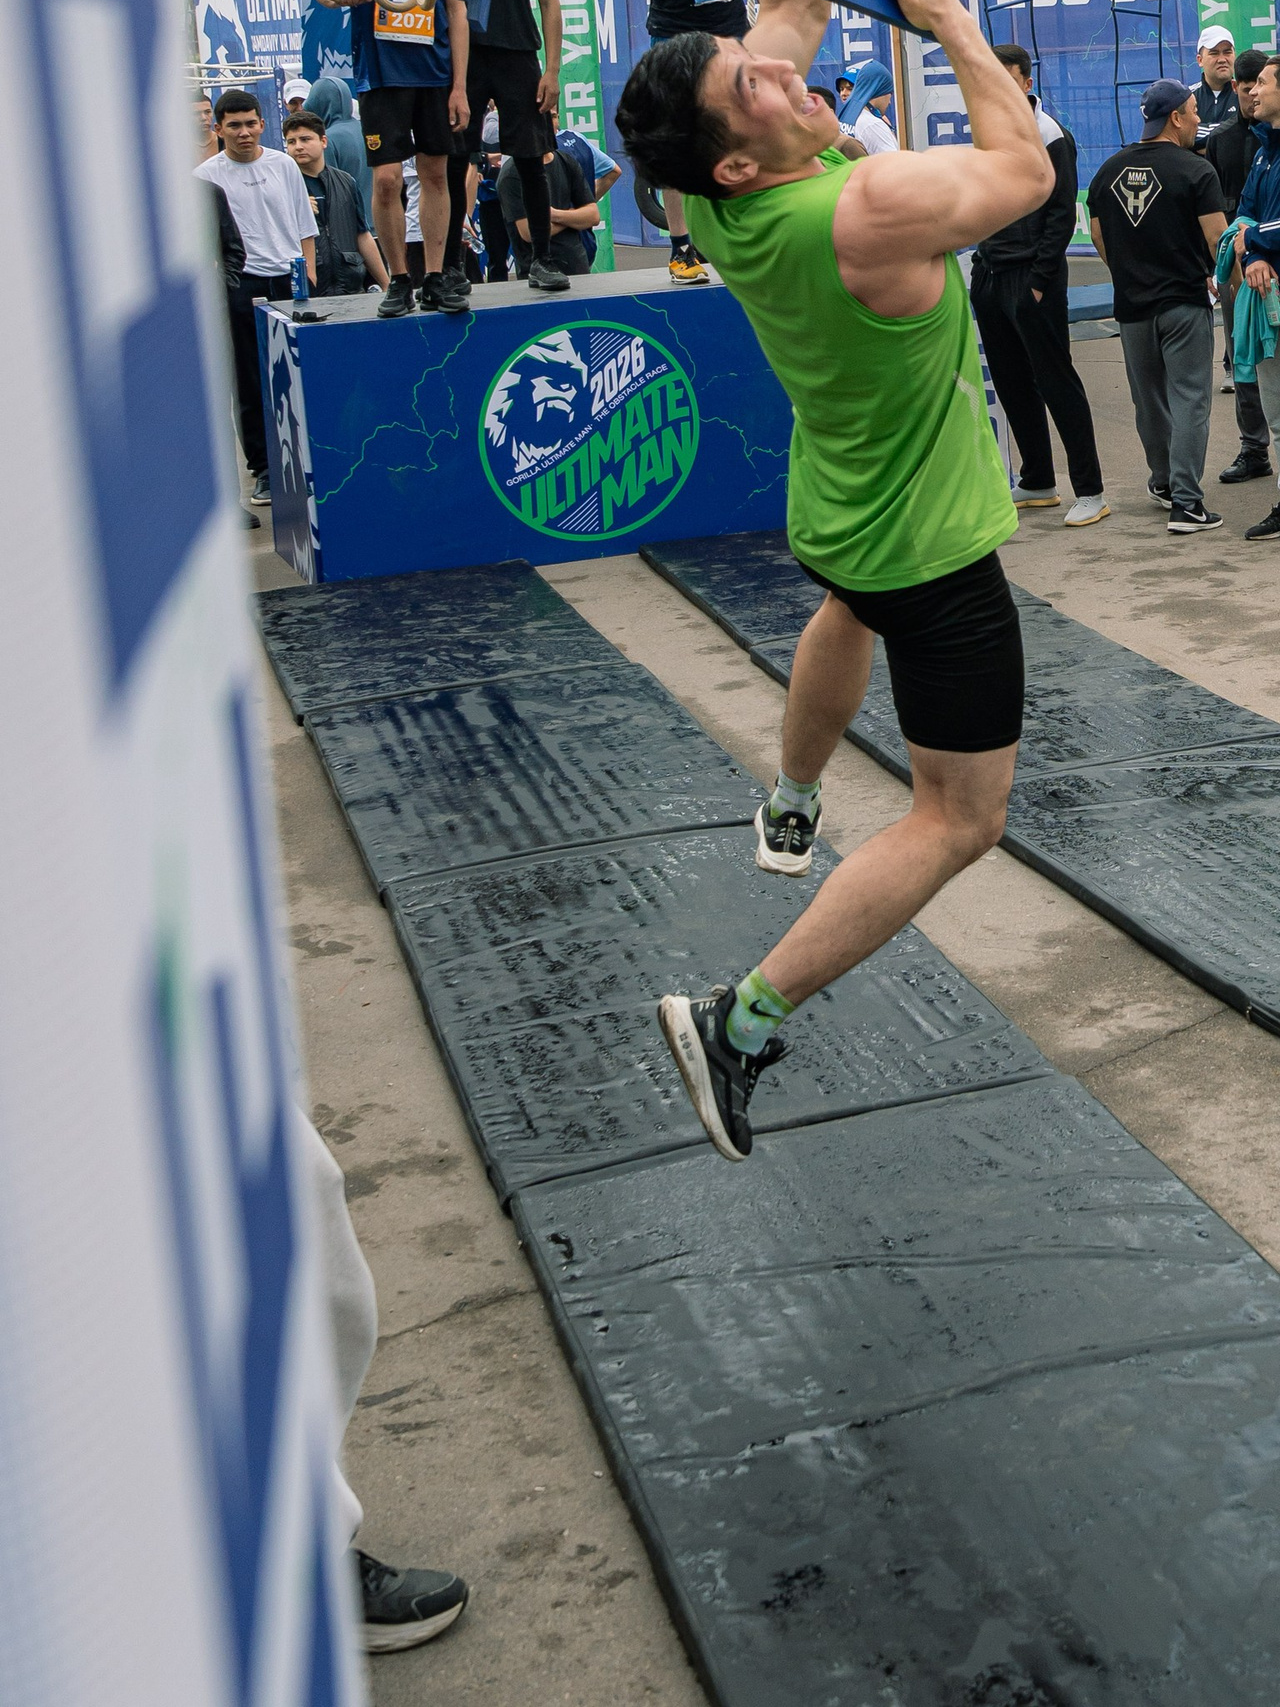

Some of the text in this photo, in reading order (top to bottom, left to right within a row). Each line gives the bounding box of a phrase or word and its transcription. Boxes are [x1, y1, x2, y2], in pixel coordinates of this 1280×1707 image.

[391, 12, 432, 31] 2071
[1127, 171, 1148, 182] MMA
[589, 335, 647, 418] 2026
[506, 464, 542, 488] GORILLA
[540, 439, 577, 470] ULTIMATE
[594, 409, 610, 423] THE
[608, 375, 646, 411] OBSTACLE
[644, 363, 669, 381] RACE
[520, 379, 690, 527] ULTIMATE
[602, 421, 691, 532] MAN
